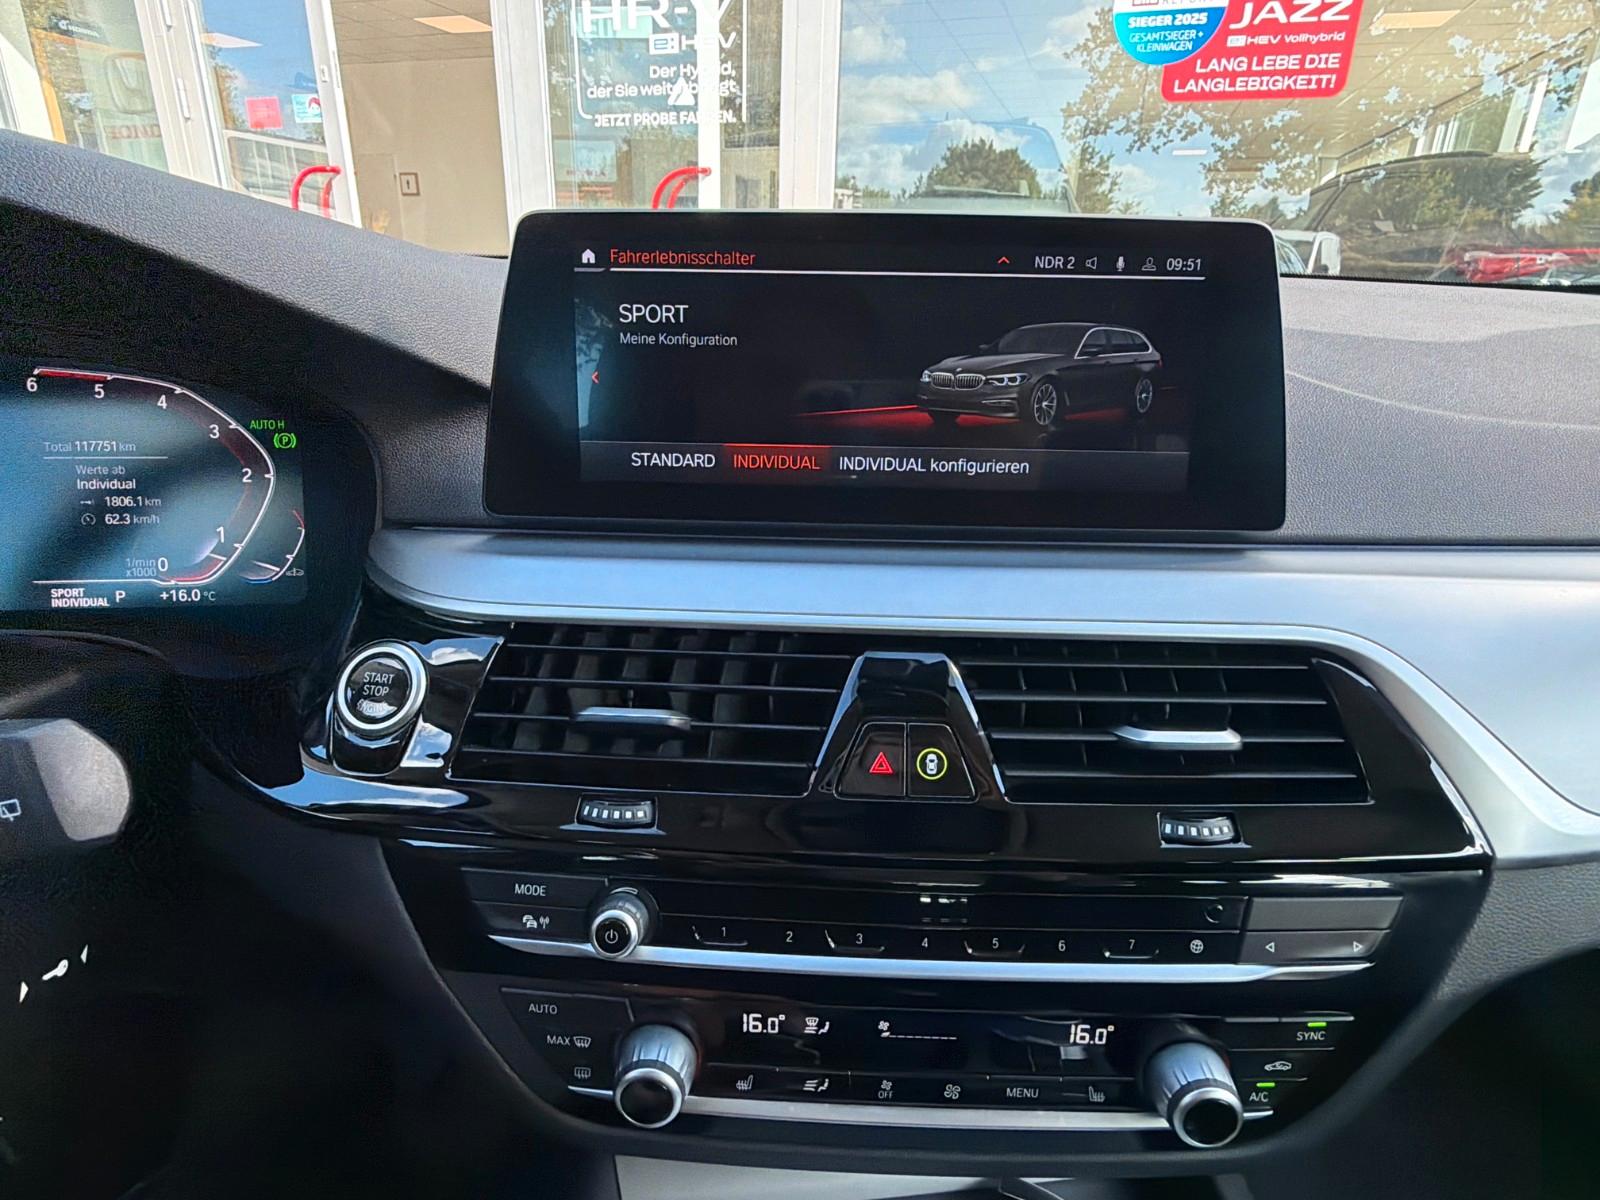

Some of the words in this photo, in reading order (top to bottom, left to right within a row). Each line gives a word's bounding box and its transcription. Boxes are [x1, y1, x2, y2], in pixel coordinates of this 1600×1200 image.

[1128, 14, 1173, 28] SIEGER
[1174, 12, 1208, 26] 2025
[1229, 0, 1351, 30] JAZZ
[1129, 29, 1196, 43] GESAMTSIEGER
[1284, 31, 1345, 45] Vollhybrid
[1136, 41, 1193, 53] KLEINWAGEN
[1195, 56, 1248, 73] LANG
[1251, 55, 1299, 71] LEBE
[1304, 53, 1342, 69] DIE
[650, 65, 677, 79] Der
[680, 62, 736, 81] Hyd,
[1173, 74, 1337, 94] LANGLEBIGKEIT!
[587, 86, 613, 99] der
[614, 83, 638, 97] Sie
[594, 113, 631, 128] JETZT
[633, 111, 677, 126] PROBE
[680, 109, 737, 125] FAEN.
[609, 248, 756, 266] Fahrerlebnisschalter
[1034, 255, 1064, 270] NDR
[1066, 256, 1076, 270] 2
[1166, 257, 1202, 271] 09:51
[618, 303, 689, 324] SPORT
[619, 331, 656, 345] Meine
[658, 332, 738, 348] Konfiguration
[26, 377, 38, 392] 6
[93, 385, 105, 399] 5
[156, 395, 168, 409] 4
[250, 419, 274, 431] AUTO
[275, 420, 285, 431] H
[209, 425, 220, 439] 3
[44, 441, 72, 452] Total
[74, 440, 117, 452] 117751
[118, 442, 136, 452] km
[630, 452, 716, 469] STANDARD
[733, 453, 821, 470] INDIVIDUAL
[839, 456, 927, 473] INDIVIDUAL
[930, 457, 1030, 476] konfigurieren
[75, 464, 109, 475] Werte
[111, 464, 126, 475] ab
[242, 469, 252, 482] 2
[77, 478, 136, 490] Individual
[105, 496, 142, 508] 1806.1
[144, 497, 161, 507] km
[105, 513, 131, 525] 62.3
[133, 514, 160, 525] km/h
[216, 526, 226, 543] 1
[126, 558, 156, 568] 1/min
[157, 557, 168, 572] 0
[126, 567, 157, 577] x1000
[51, 588, 84, 598] SPORT
[115, 590, 126, 603] P
[160, 589, 201, 602] +16.0
[51, 597, 110, 608] INDIVIDUAL
[364, 672, 394, 684] START
[363, 685, 389, 696] STOP
[514, 883, 546, 898] MODE
[721, 926, 727, 938] 1
[785, 931, 794, 943] 2
[856, 933, 864, 945] 3
[920, 936, 929, 948] 4
[991, 937, 1000, 949] 5
[1127, 938, 1136, 951] 7
[1058, 940, 1067, 952] 6
[528, 1003, 558, 1015] AUTO
[546, 1034, 571, 1047] MAX
[1295, 1030, 1326, 1043] SYNC
[877, 1087, 894, 1099] OFF
[1005, 1086, 1039, 1099] MENU
[1249, 1091, 1269, 1103] A/C
